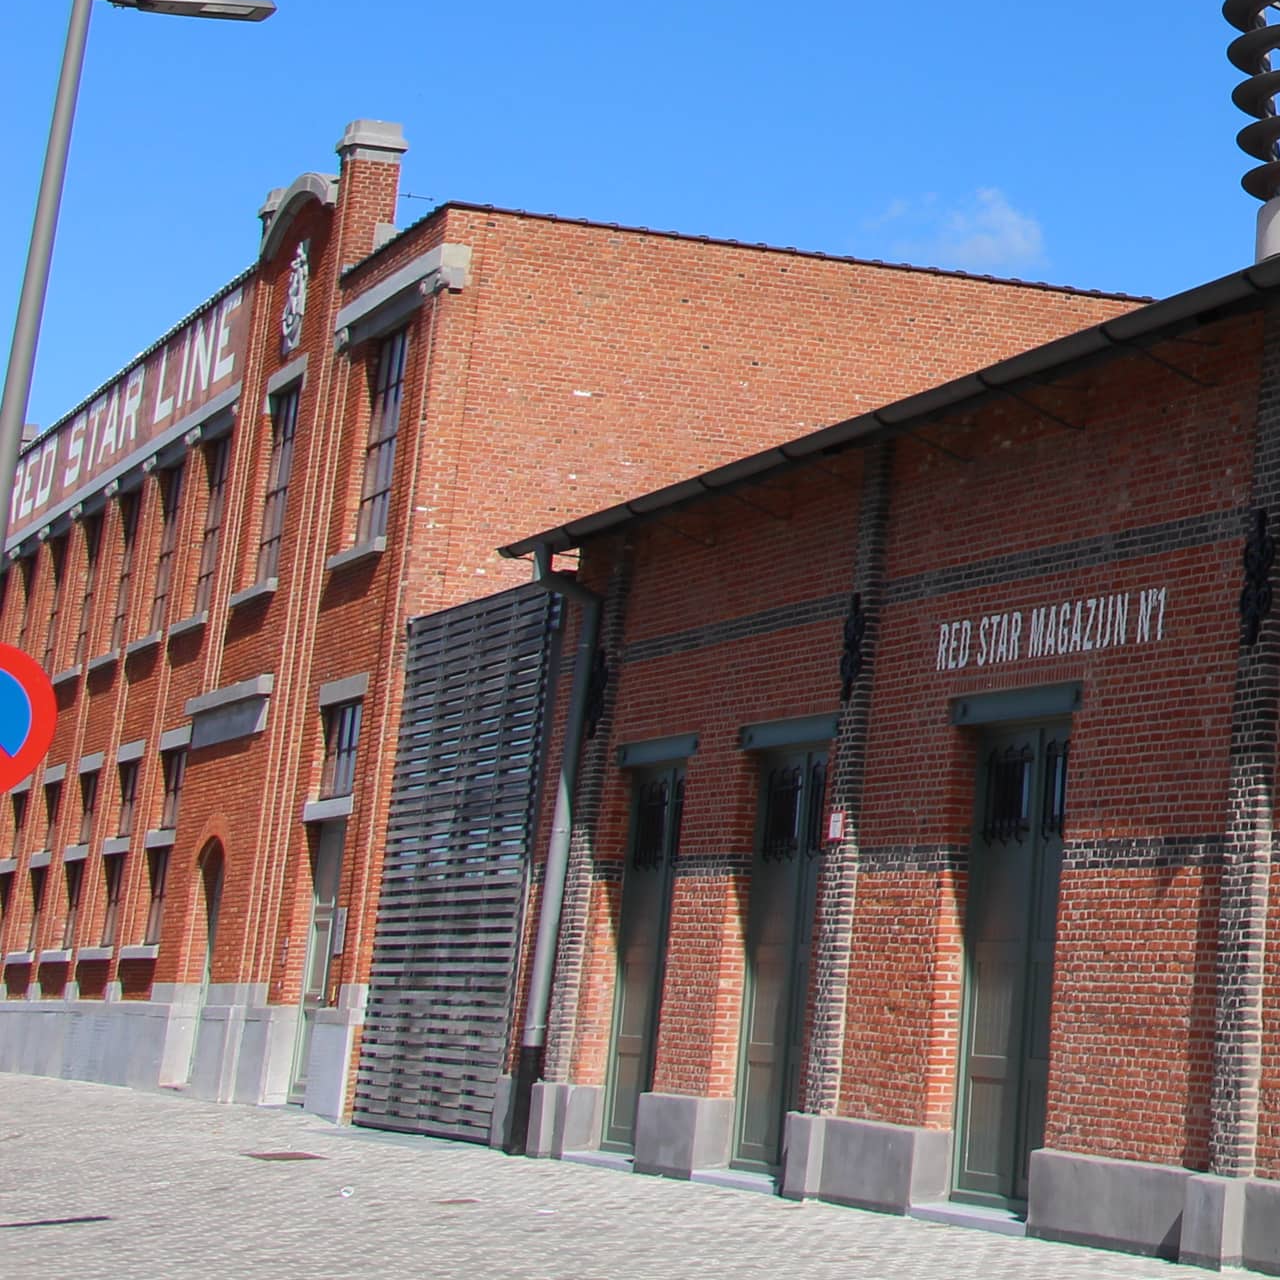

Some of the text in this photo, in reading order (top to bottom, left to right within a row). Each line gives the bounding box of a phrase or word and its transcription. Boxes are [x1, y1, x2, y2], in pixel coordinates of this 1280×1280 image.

[63, 363, 146, 488] STAR
[153, 286, 244, 425] LINE
[936, 620, 971, 671] RED
[977, 611, 1022, 667] STAR
[1028, 592, 1129, 658] MAGAZIJN
